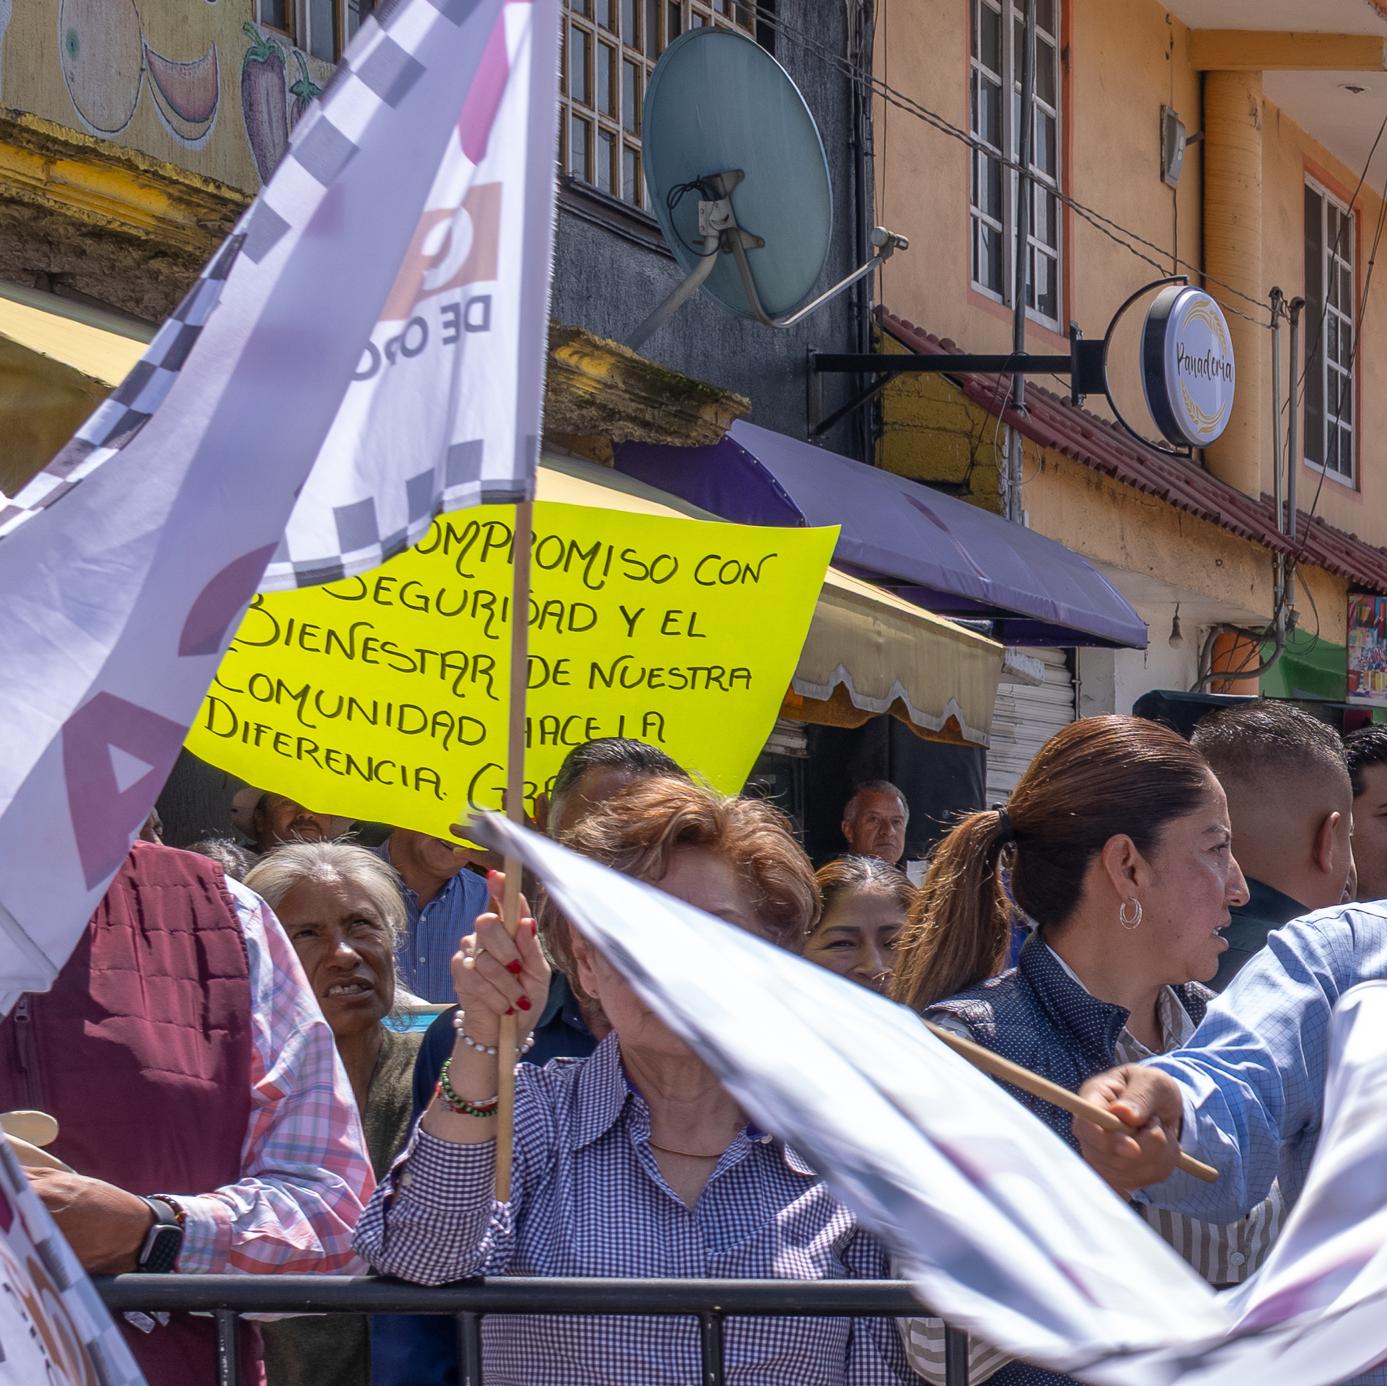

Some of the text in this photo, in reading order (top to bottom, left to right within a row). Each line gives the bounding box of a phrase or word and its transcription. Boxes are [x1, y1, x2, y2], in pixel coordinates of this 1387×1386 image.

[411, 519, 778, 591] OMPOMISO CON
[618, 604, 645, 638] Y
[660, 610, 707, 638] EL
[525, 655, 571, 690] DE
[588, 655, 753, 692] NUESTRA
